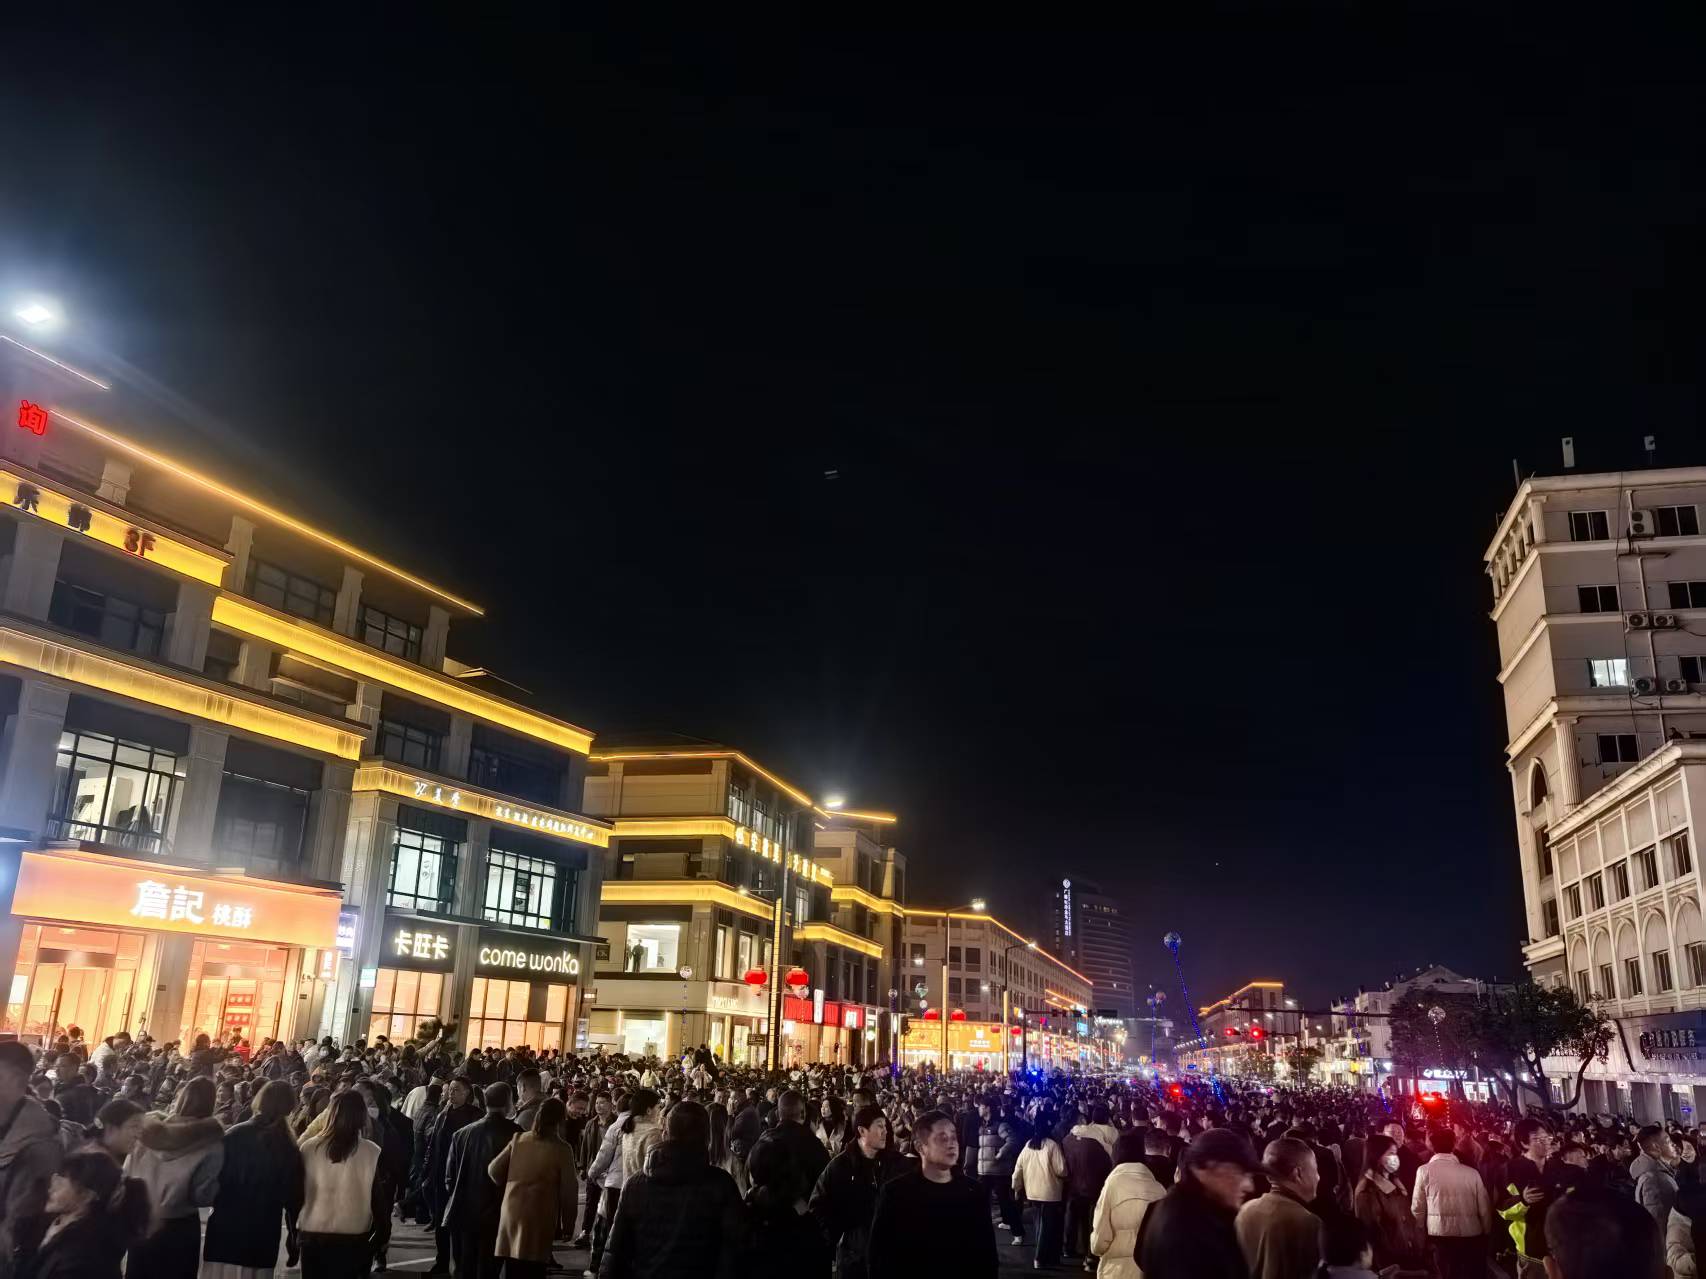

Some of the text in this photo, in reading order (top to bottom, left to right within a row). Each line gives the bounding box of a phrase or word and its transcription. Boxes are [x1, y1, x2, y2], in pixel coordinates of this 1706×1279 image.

[18, 400, 48, 436] 询
[131, 879, 205, 925] 詹記
[393, 928, 449, 961] 卡旺卡
[479, 946, 527, 970] come
